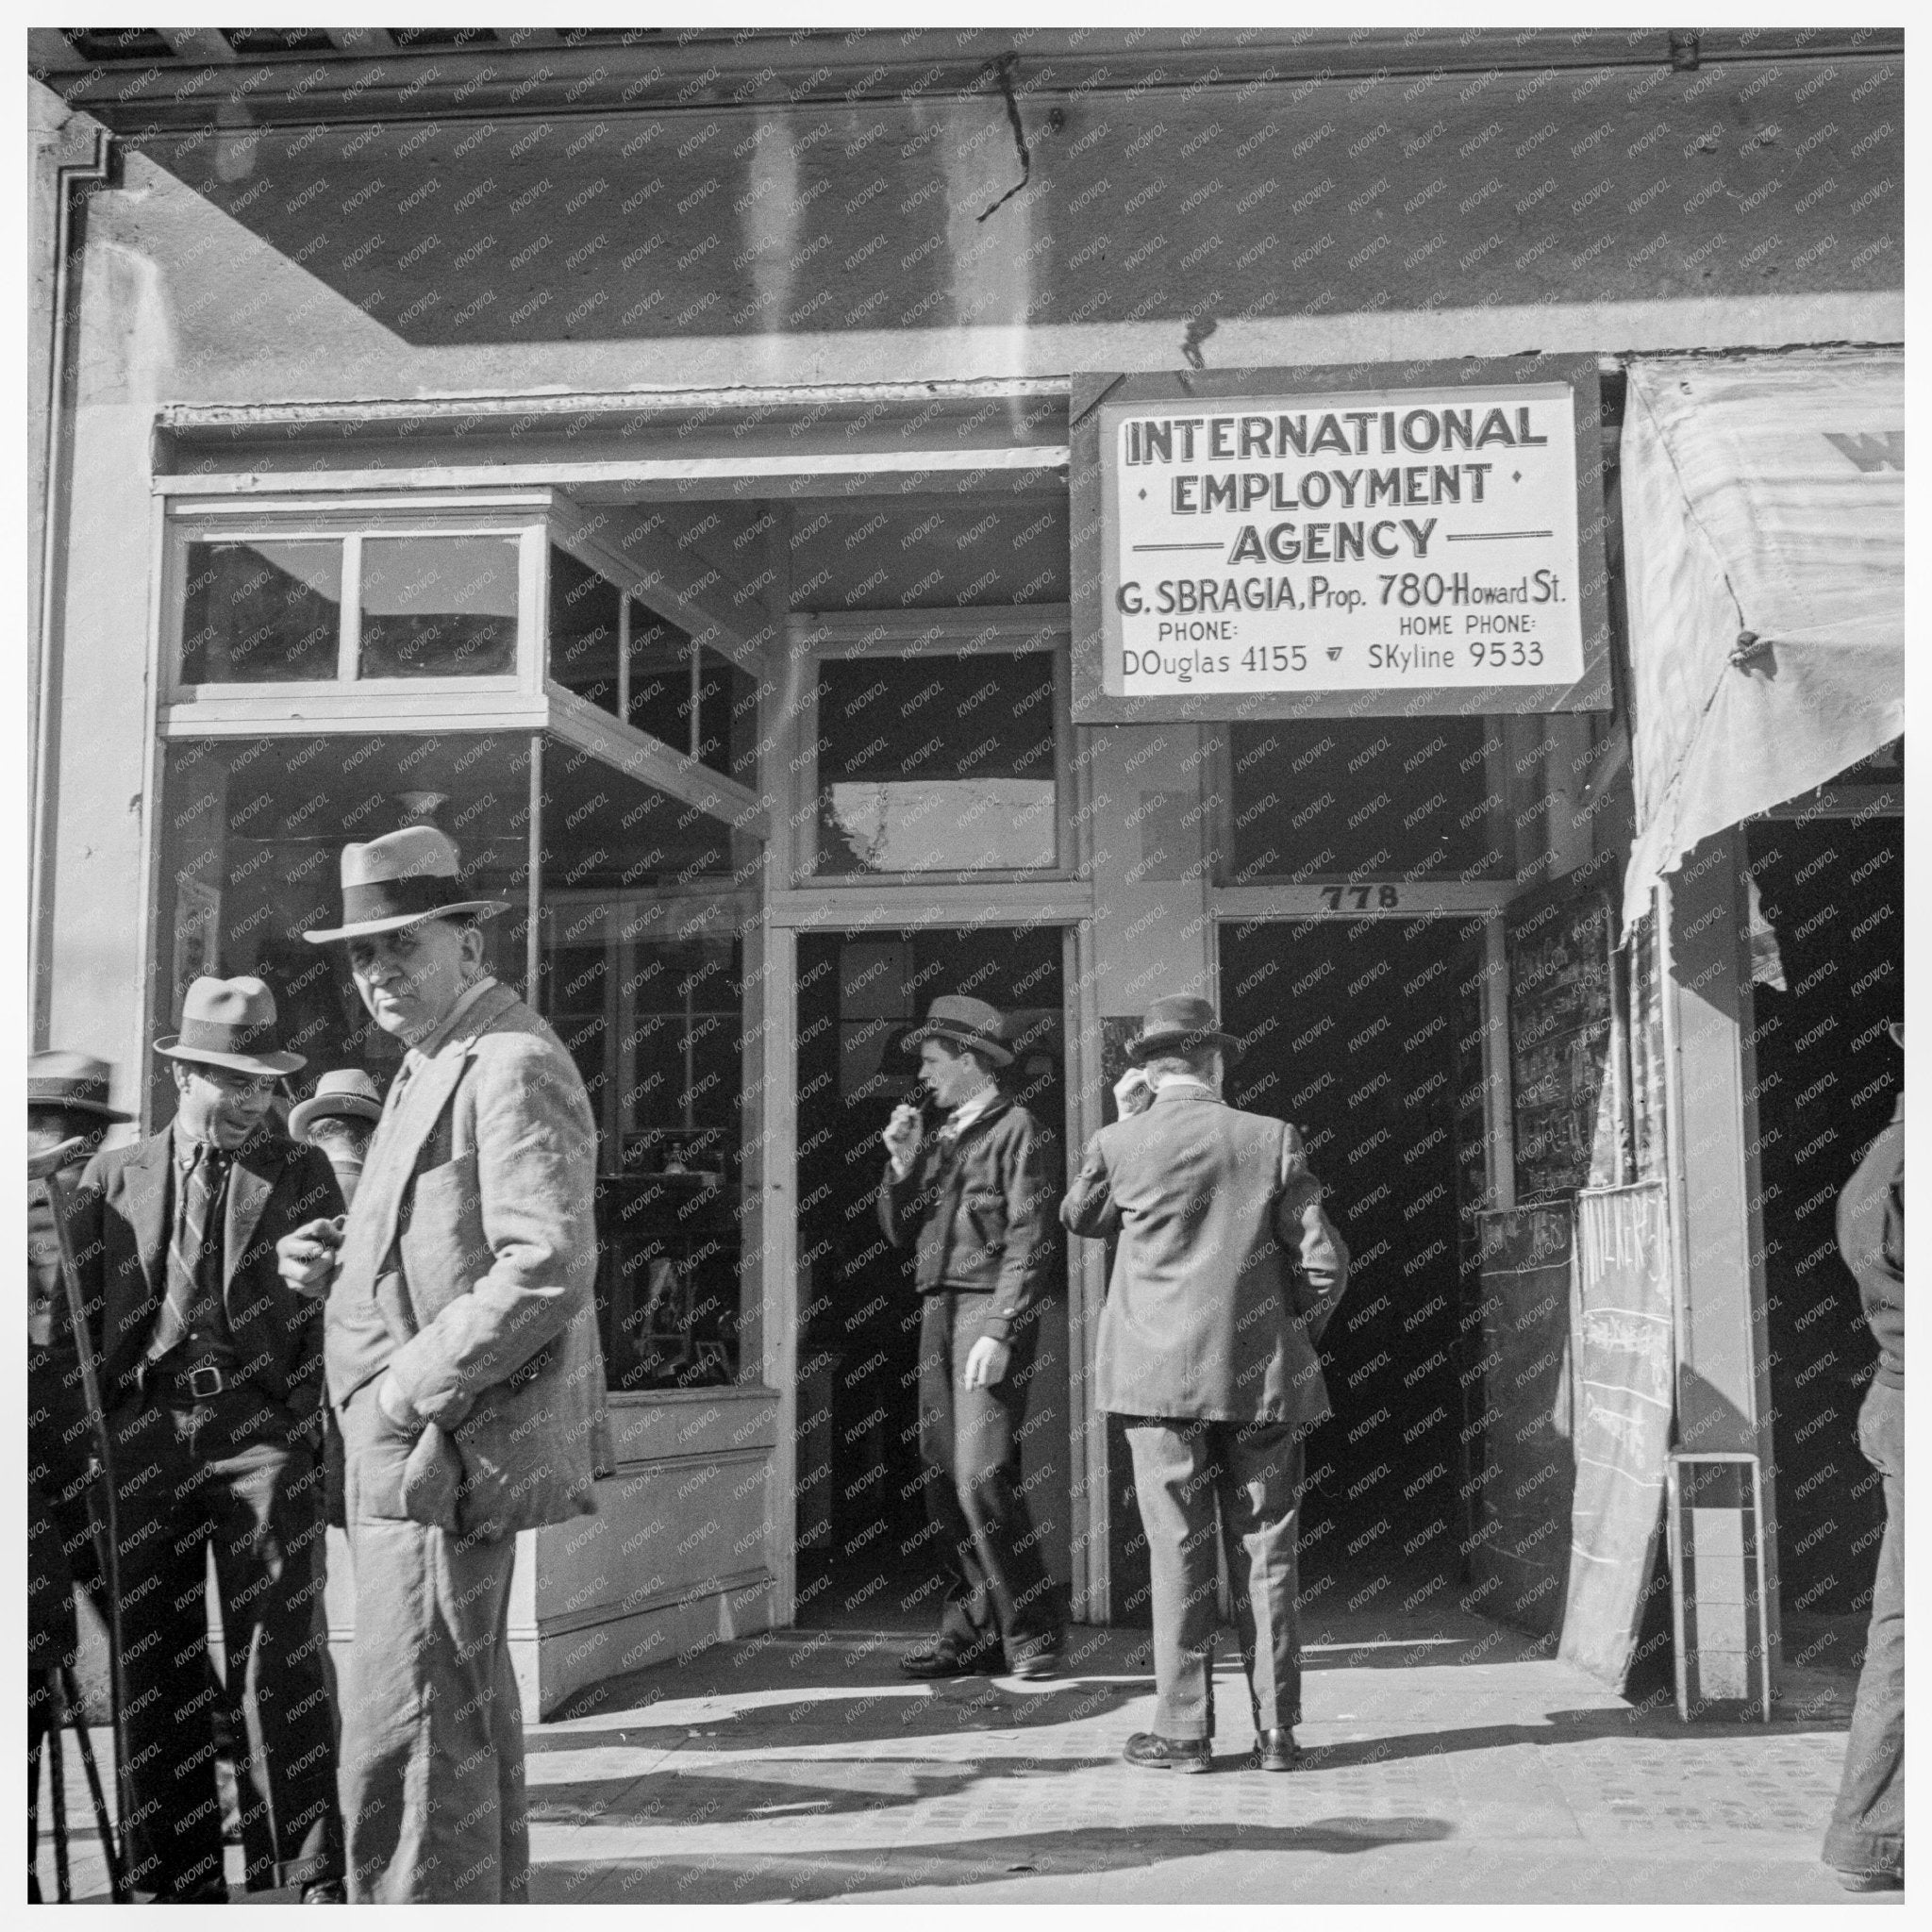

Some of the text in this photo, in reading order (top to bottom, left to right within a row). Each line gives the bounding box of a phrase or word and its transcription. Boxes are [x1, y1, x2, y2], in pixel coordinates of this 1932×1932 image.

[1126, 407, 1547, 465] INTERNATIONAL
[1172, 463, 1491, 514] EMPLOYMENT
[1227, 518, 1438, 564] AGENCY
[1116, 581, 1151, 616] G.
[1157, 576, 1306, 614] SBRAGIA,
[1308, 575, 1366, 613] Prop.
[1532, 569, 1566, 604] St.
[1158, 621, 1239, 641] PHONE:
[1400, 614, 1536, 636] HOME PHONE:
[1123, 645, 1307, 683] DOuglas 4155
[1369, 641, 1544, 674] SKyline 9533
[1321, 885, 1398, 910] 778
